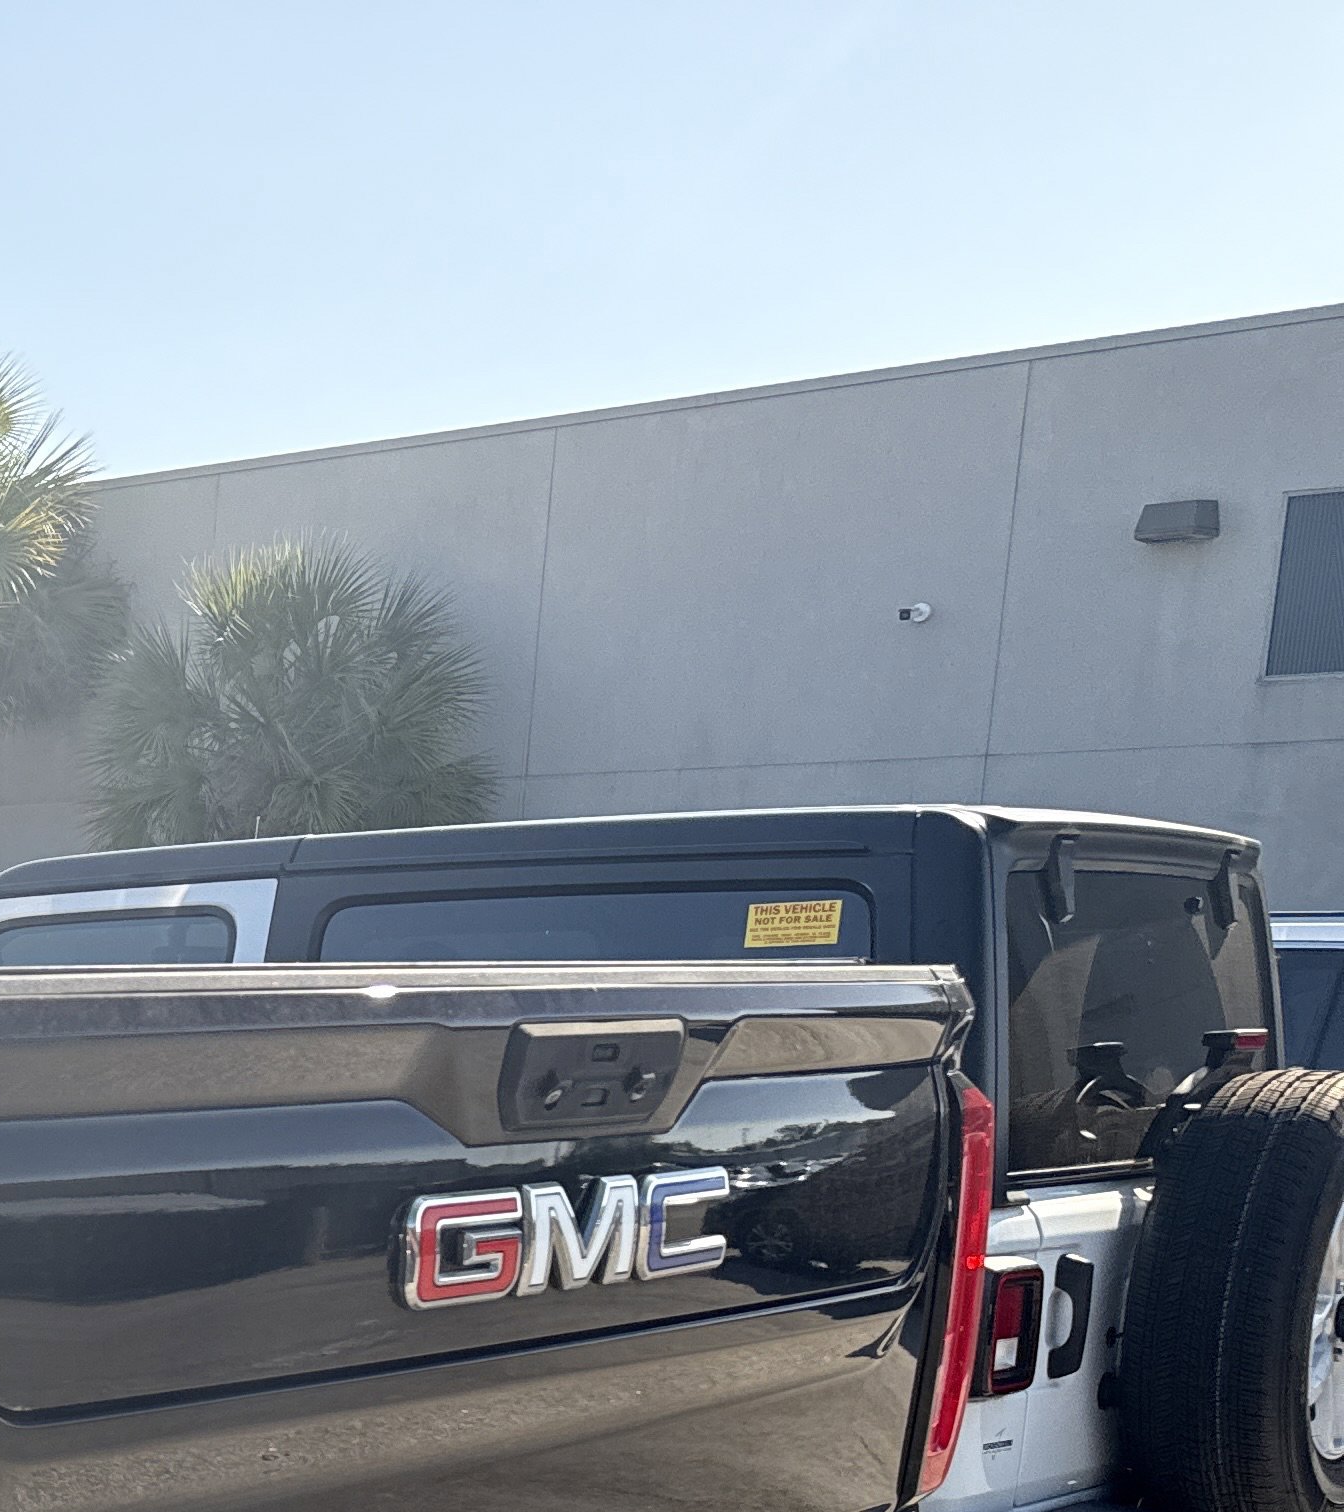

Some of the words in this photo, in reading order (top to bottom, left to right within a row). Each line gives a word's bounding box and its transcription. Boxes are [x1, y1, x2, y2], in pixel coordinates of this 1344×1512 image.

[754, 905, 780, 916] THIS
[784, 902, 837, 914] VEHICLE
[754, 917, 777, 926] NOT
[779, 916, 802, 924] FOR
[804, 914, 833, 923] SALE
[402, 1165, 730, 1310] GMC
